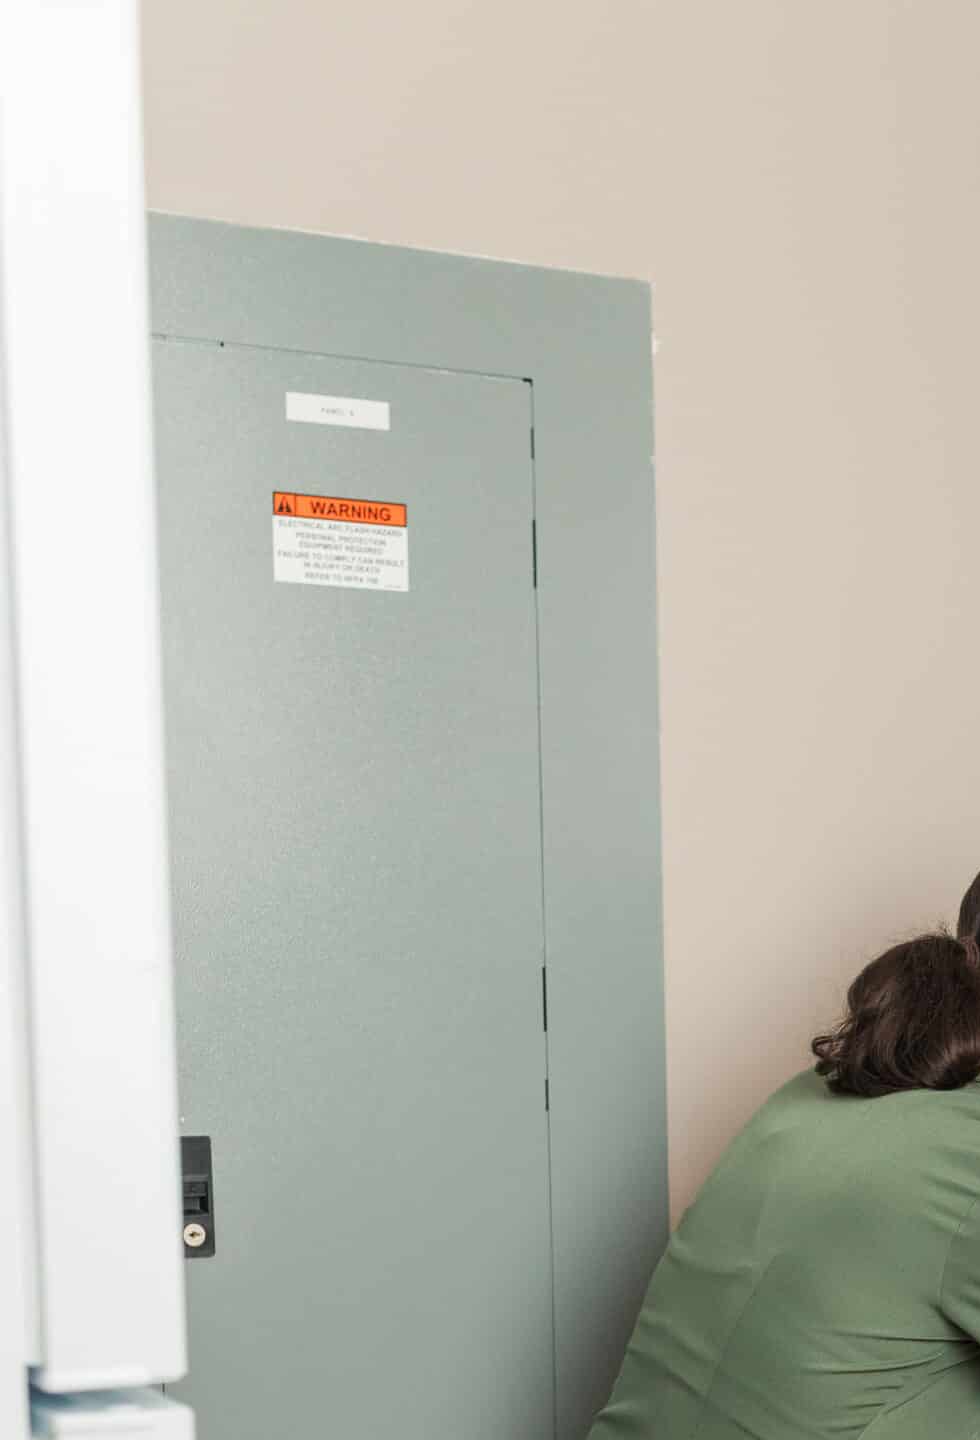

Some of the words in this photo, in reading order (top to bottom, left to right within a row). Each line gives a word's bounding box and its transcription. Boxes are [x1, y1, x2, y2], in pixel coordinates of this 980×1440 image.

[309, 500, 392, 522] WARNING
[277, 549, 309, 560] FAILURE
[312, 552, 322, 560] TO
